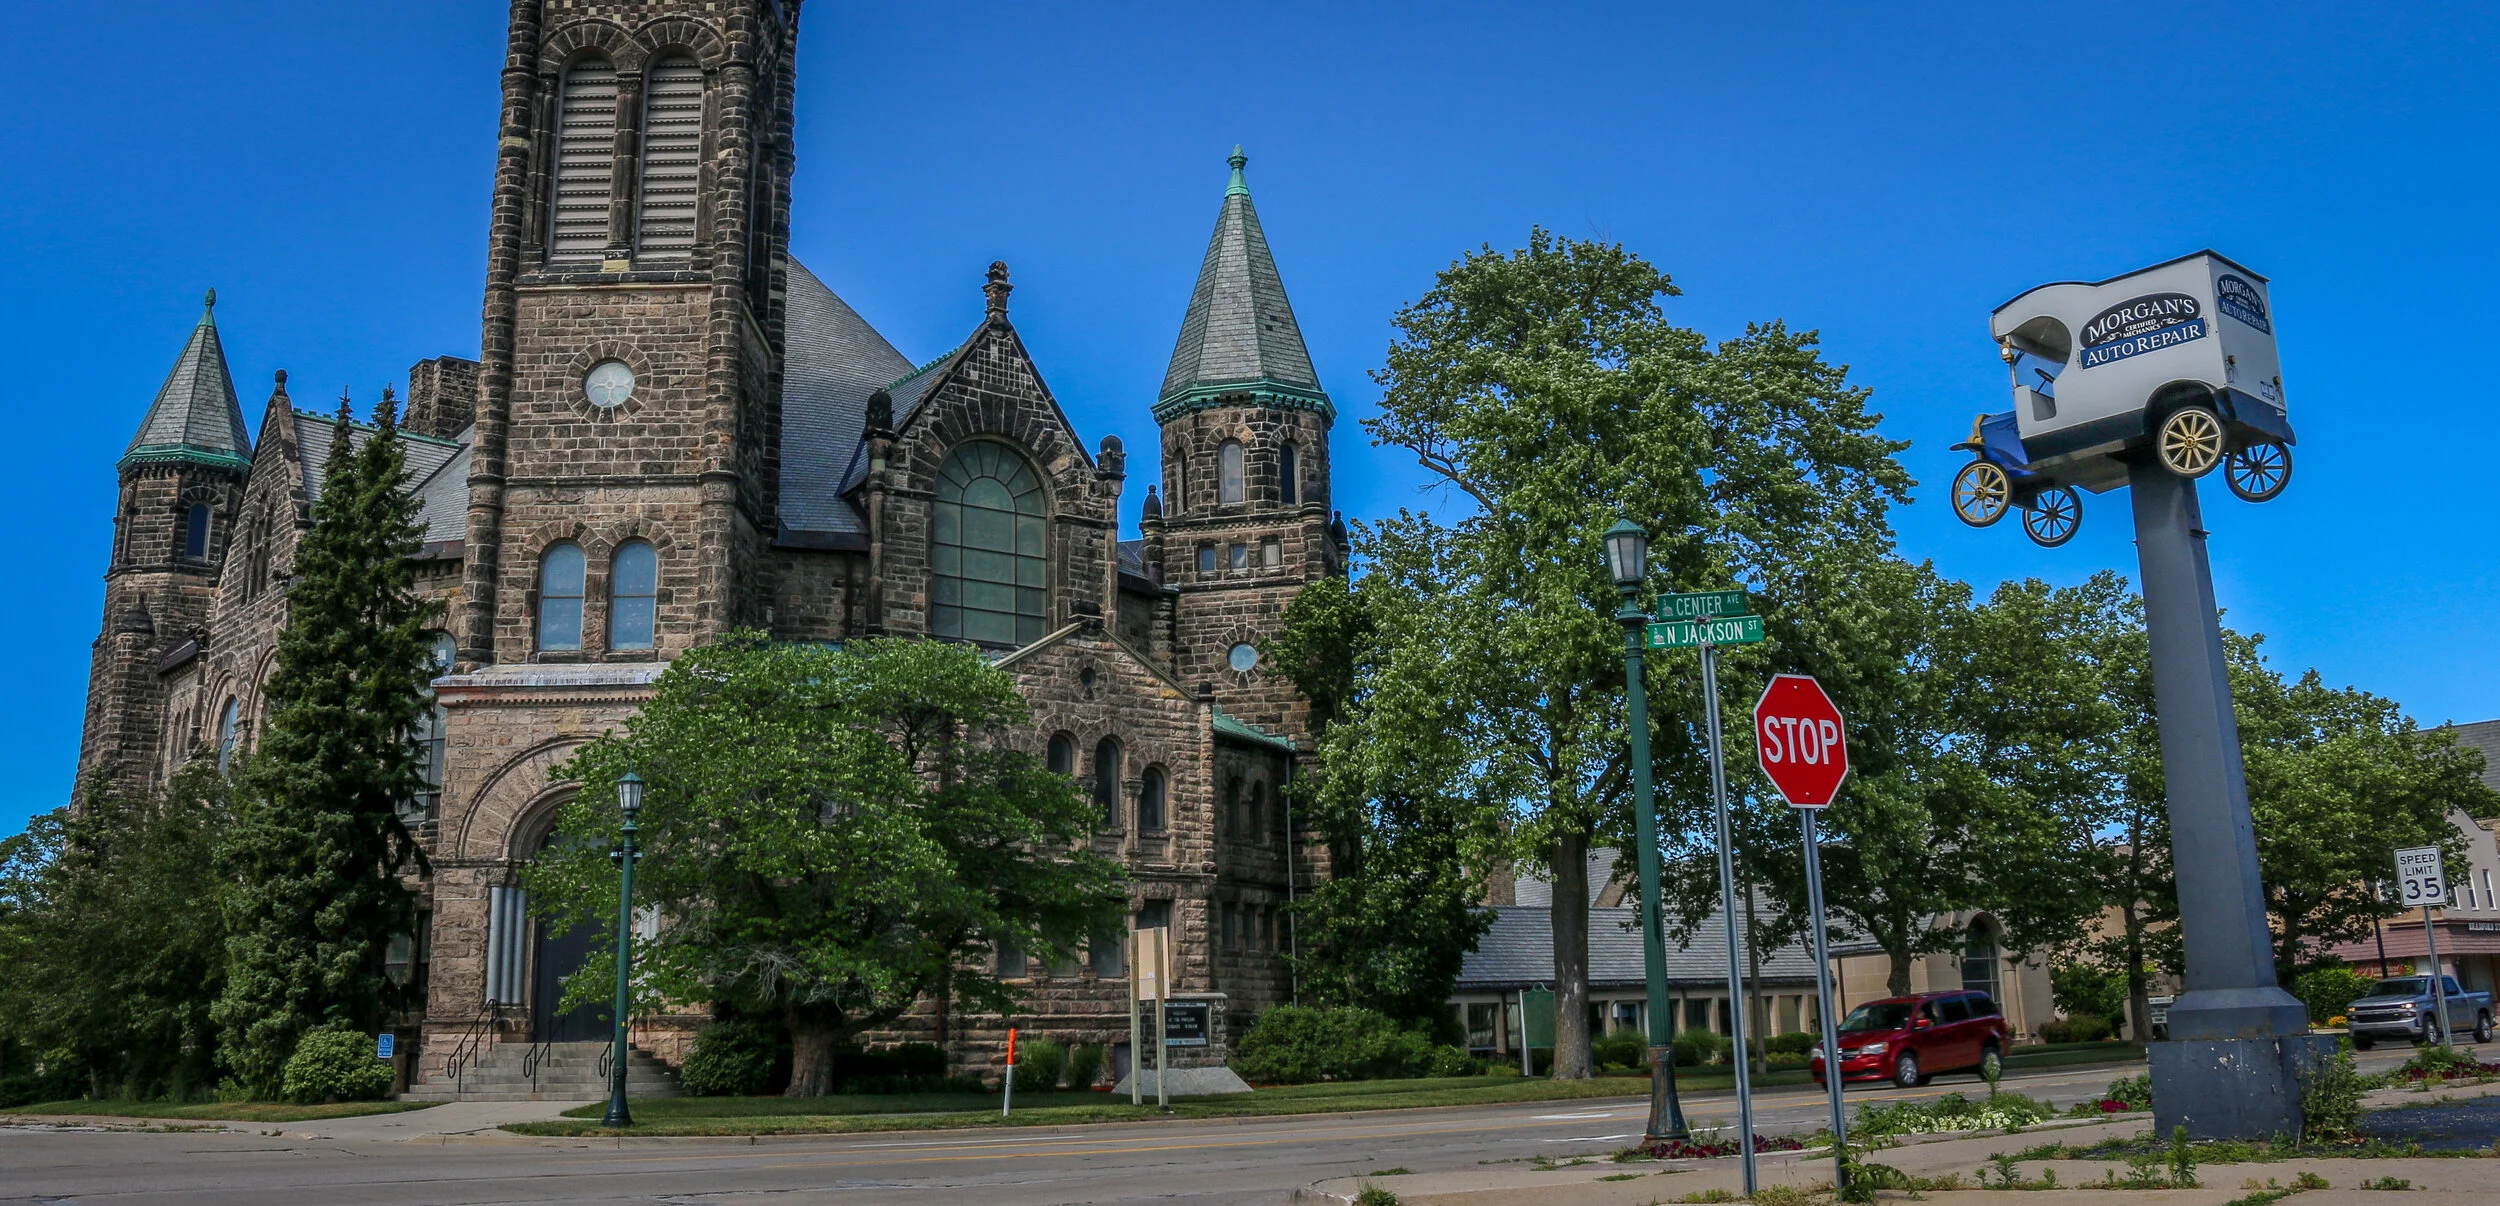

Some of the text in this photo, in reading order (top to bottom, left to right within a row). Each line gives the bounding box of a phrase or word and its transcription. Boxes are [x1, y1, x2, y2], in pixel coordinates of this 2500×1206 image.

[2220, 279, 2264, 313] MORGAN'S
[2088, 298, 2195, 343] MORGAN'S
[2125, 319, 2157, 332] CERTIFIED
[2221, 301, 2268, 331] AUTO REPAIR
[2123, 324, 2161, 338] MECHANICS
[2086, 324, 2202, 366] AUTO REPAIR
[1676, 594, 1740, 616] CENTER AVE
[1667, 620, 1757, 644] N JACKSON ST
[1763, 715, 1838, 765] STOP
[2400, 853, 2436, 865] SPEED
[2404, 866, 2433, 876] LIMIT
[2405, 877, 2440, 900] 35
